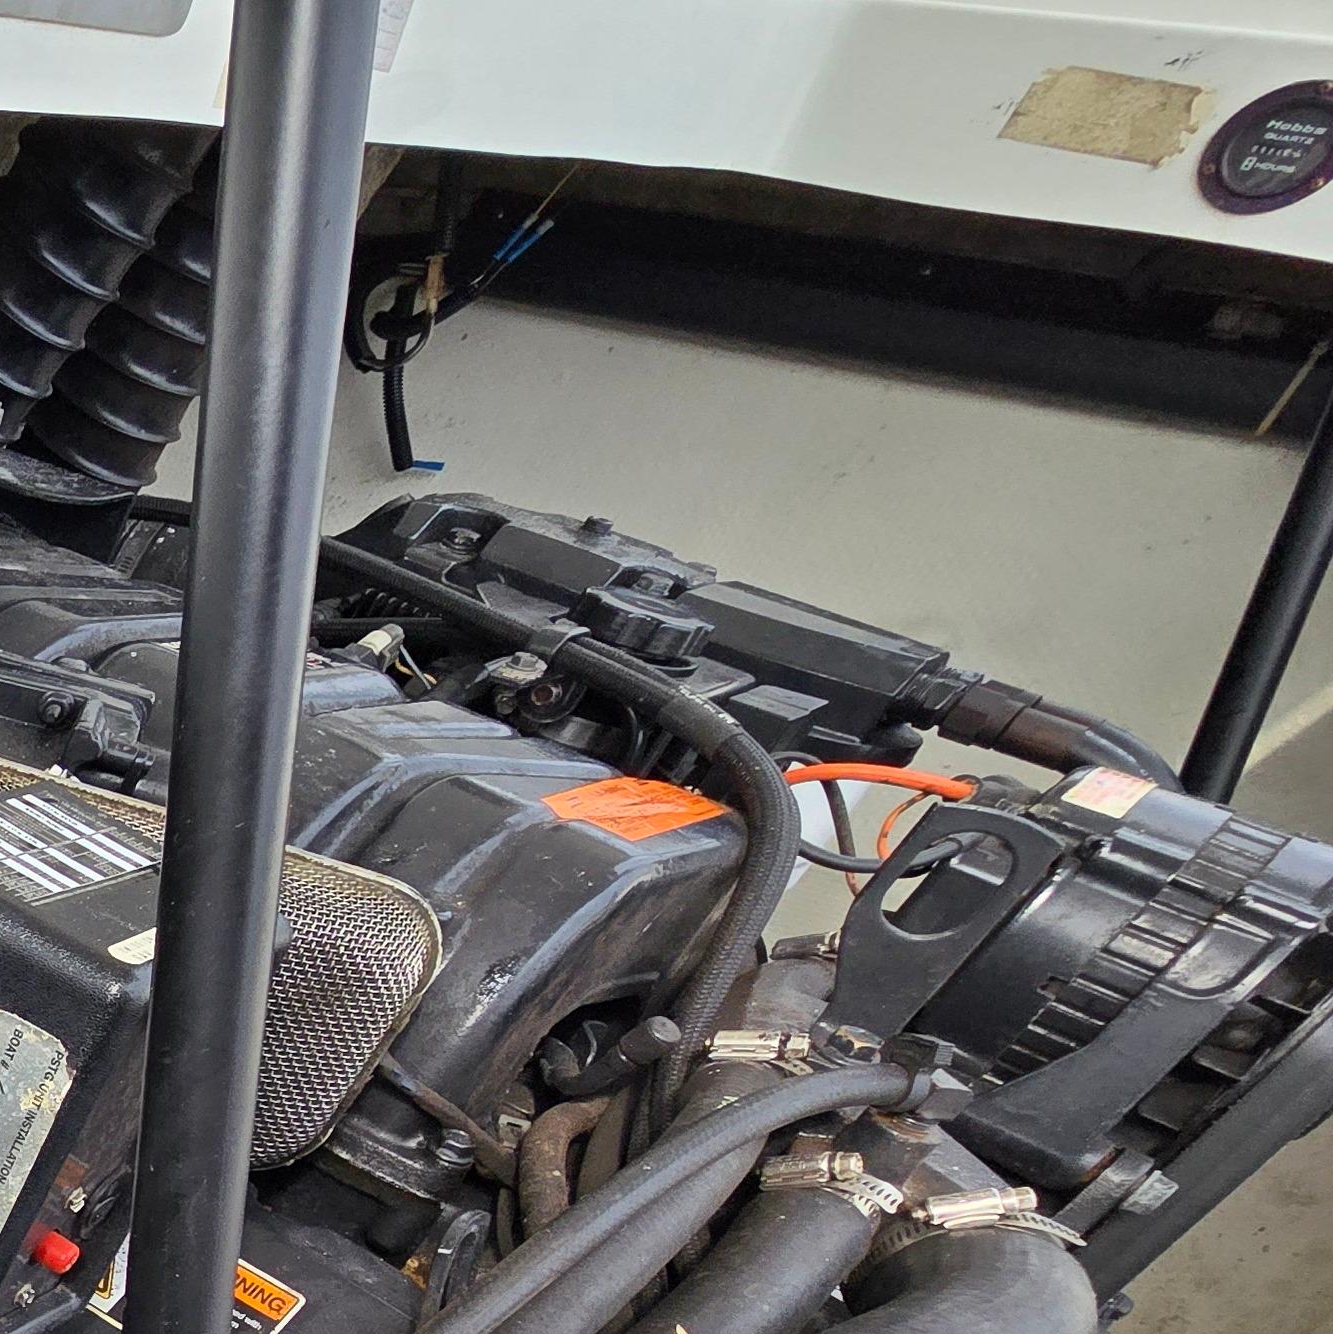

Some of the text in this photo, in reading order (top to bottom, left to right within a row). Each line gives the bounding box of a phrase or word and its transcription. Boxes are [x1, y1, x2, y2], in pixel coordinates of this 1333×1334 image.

[1266, 119, 1327, 136] Hobbs
[1, 1027, 24, 1061] BOAT
[30, 1082, 49, 1110] UNIT
[231, 1273, 287, 1316] NING
